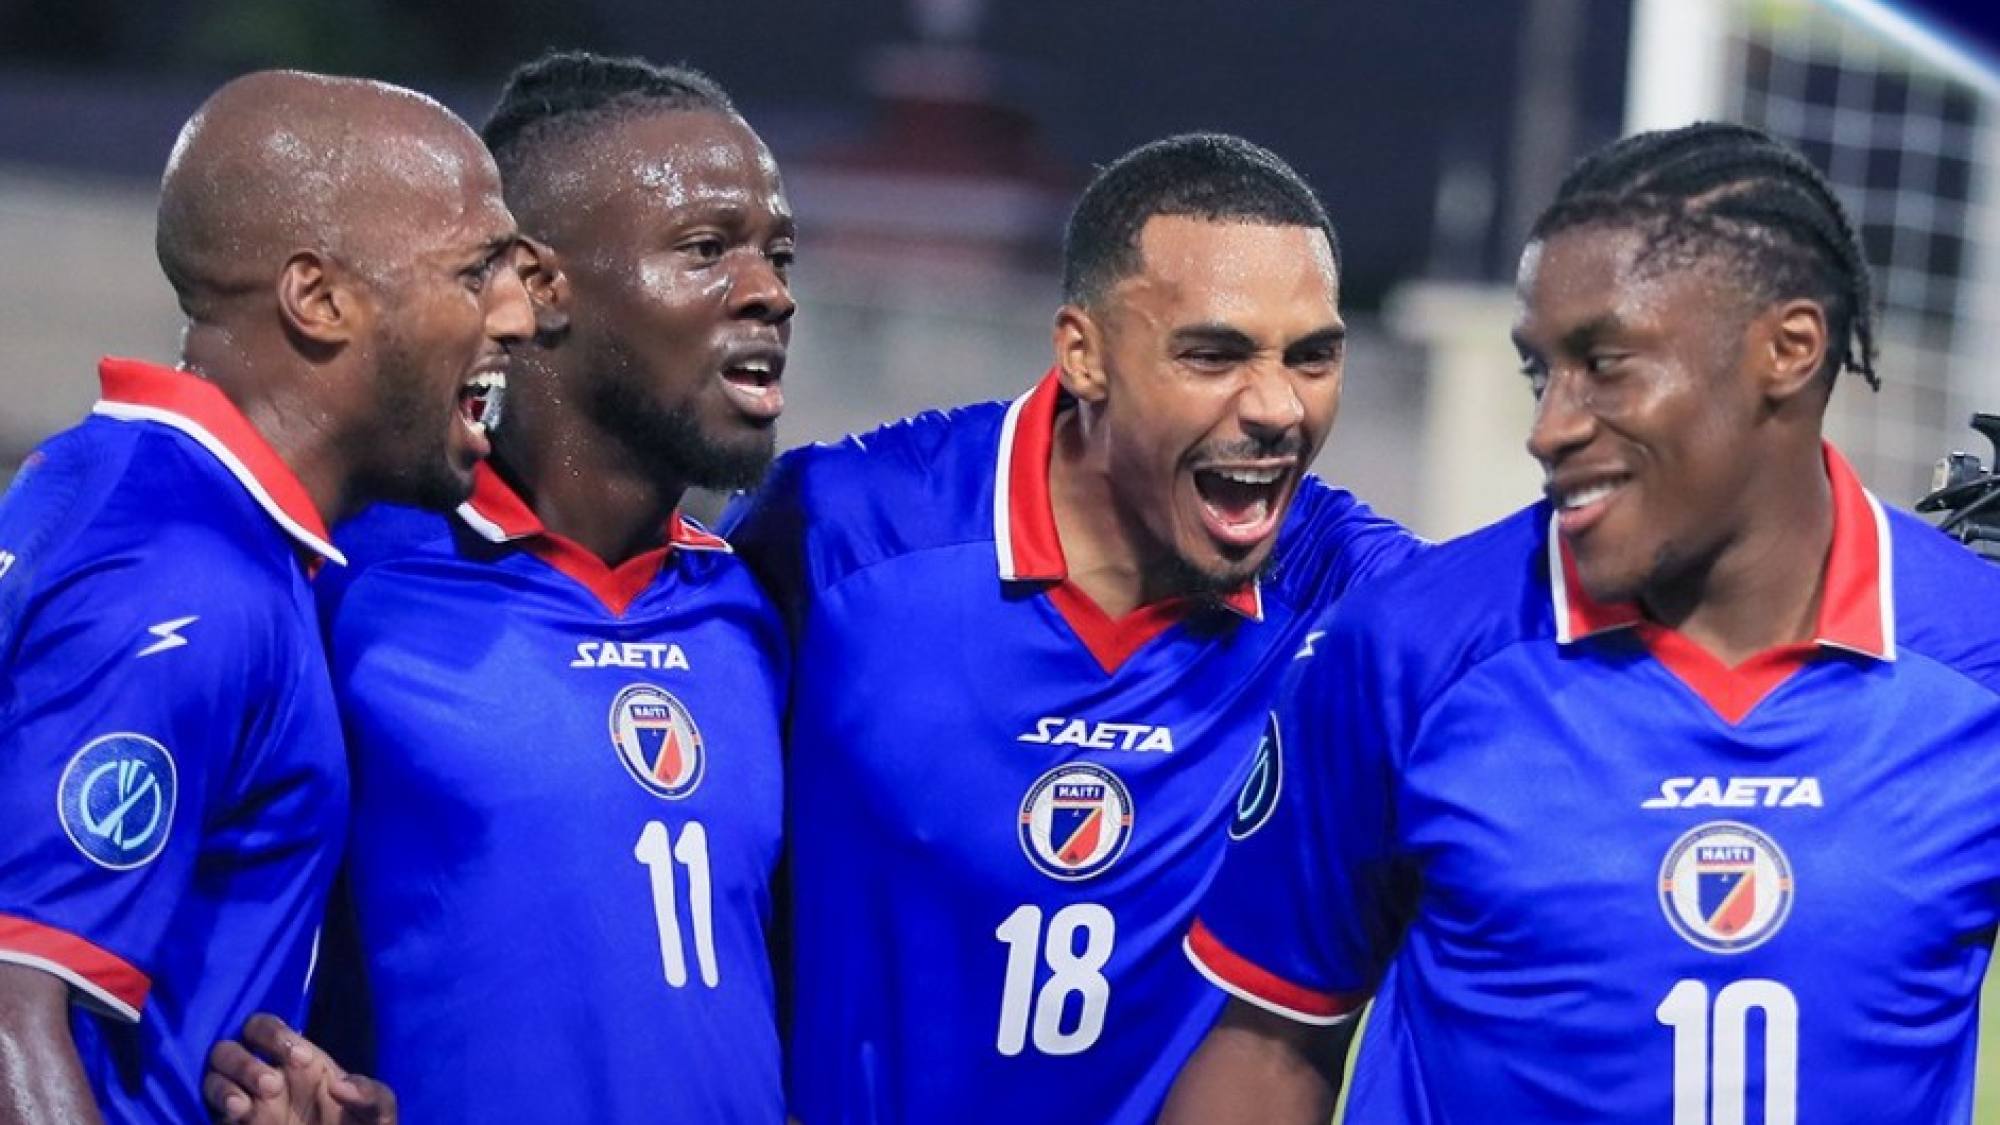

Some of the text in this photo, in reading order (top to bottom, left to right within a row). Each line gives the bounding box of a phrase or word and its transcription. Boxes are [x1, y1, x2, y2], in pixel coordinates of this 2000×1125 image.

[569, 642, 690, 671] SAETA
[1017, 717, 1174, 753] SAETA
[1058, 786, 1100, 797] HAITI
[1641, 776, 1824, 809] SAETA
[1702, 848, 1749, 860] HAITI
[634, 820, 720, 989] 11
[995, 903, 1115, 1056] 18
[1655, 978, 1799, 1125] 10
